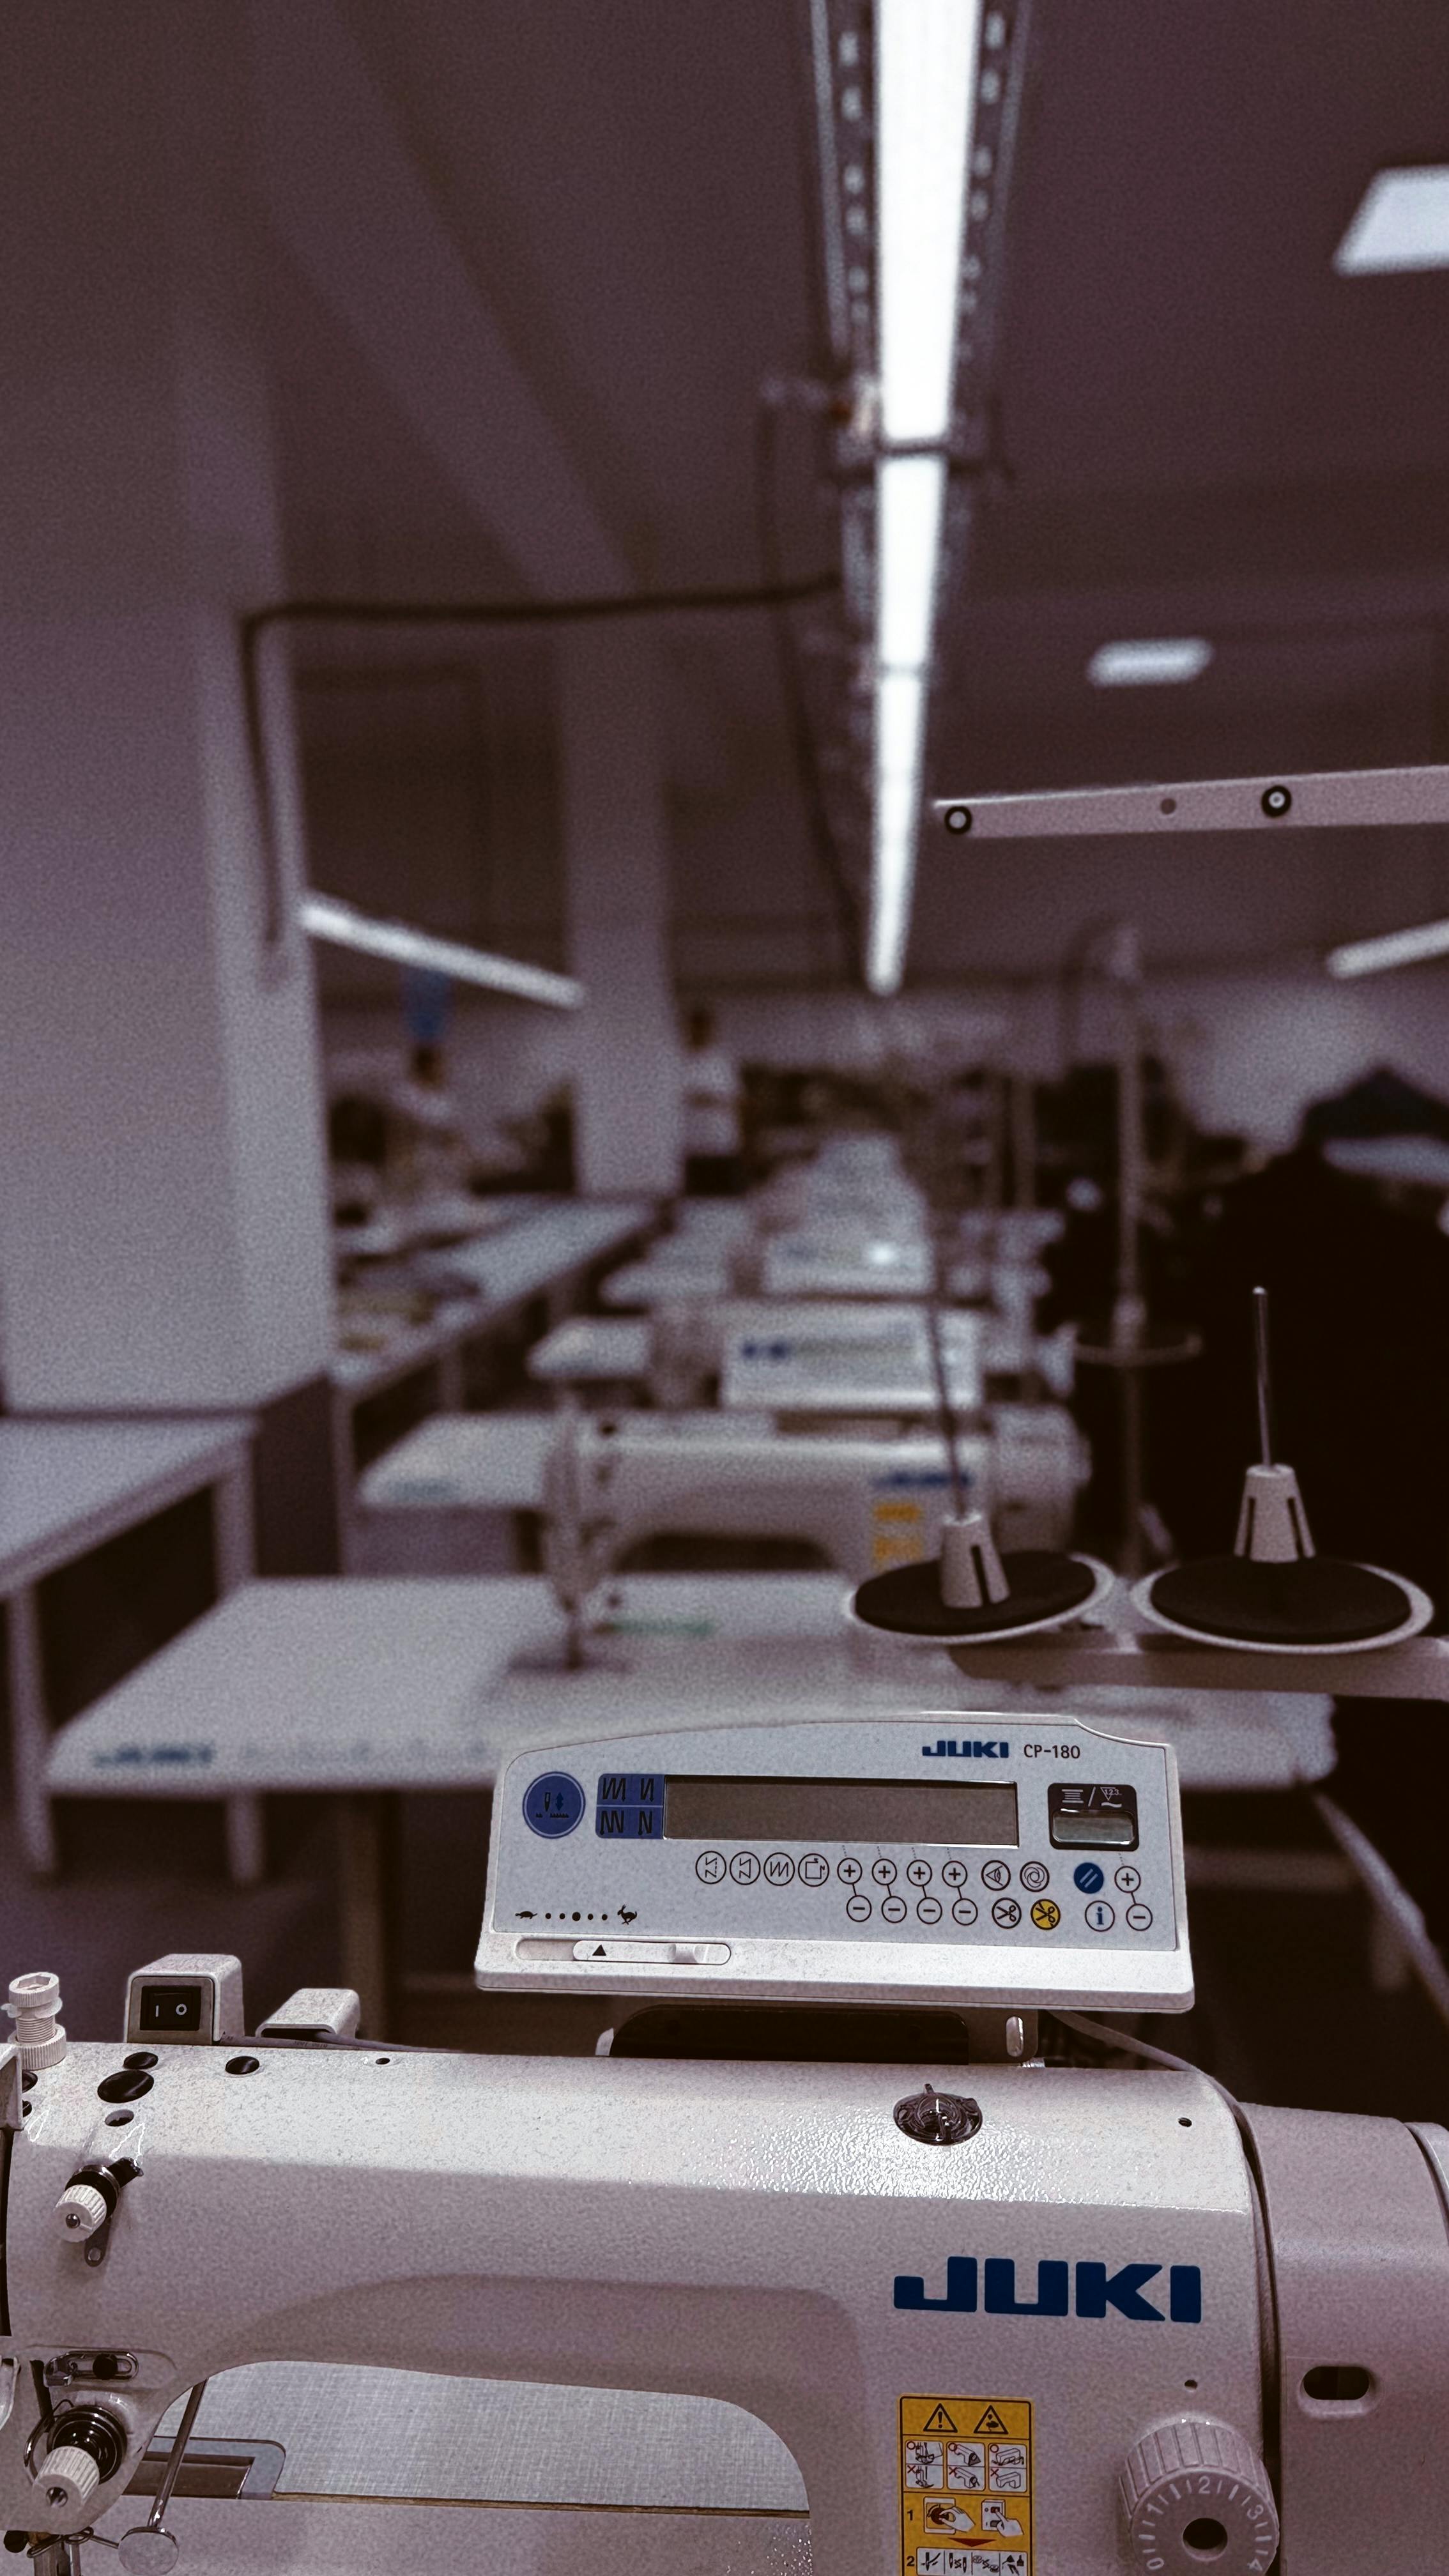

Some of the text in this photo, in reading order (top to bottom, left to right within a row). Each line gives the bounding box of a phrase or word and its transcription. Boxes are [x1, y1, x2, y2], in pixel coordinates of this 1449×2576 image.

[922, 1740, 1080, 1758] JUKI CP-180
[894, 2256, 1201, 2323] JUKI
[1147, 2503, 1163, 2515] 1
[1198, 2476, 1210, 2494] 2
[1247, 2504, 1264, 2520] 3
[907, 2510, 914, 2521] 1
[907, 2556, 915, 2567] 2
